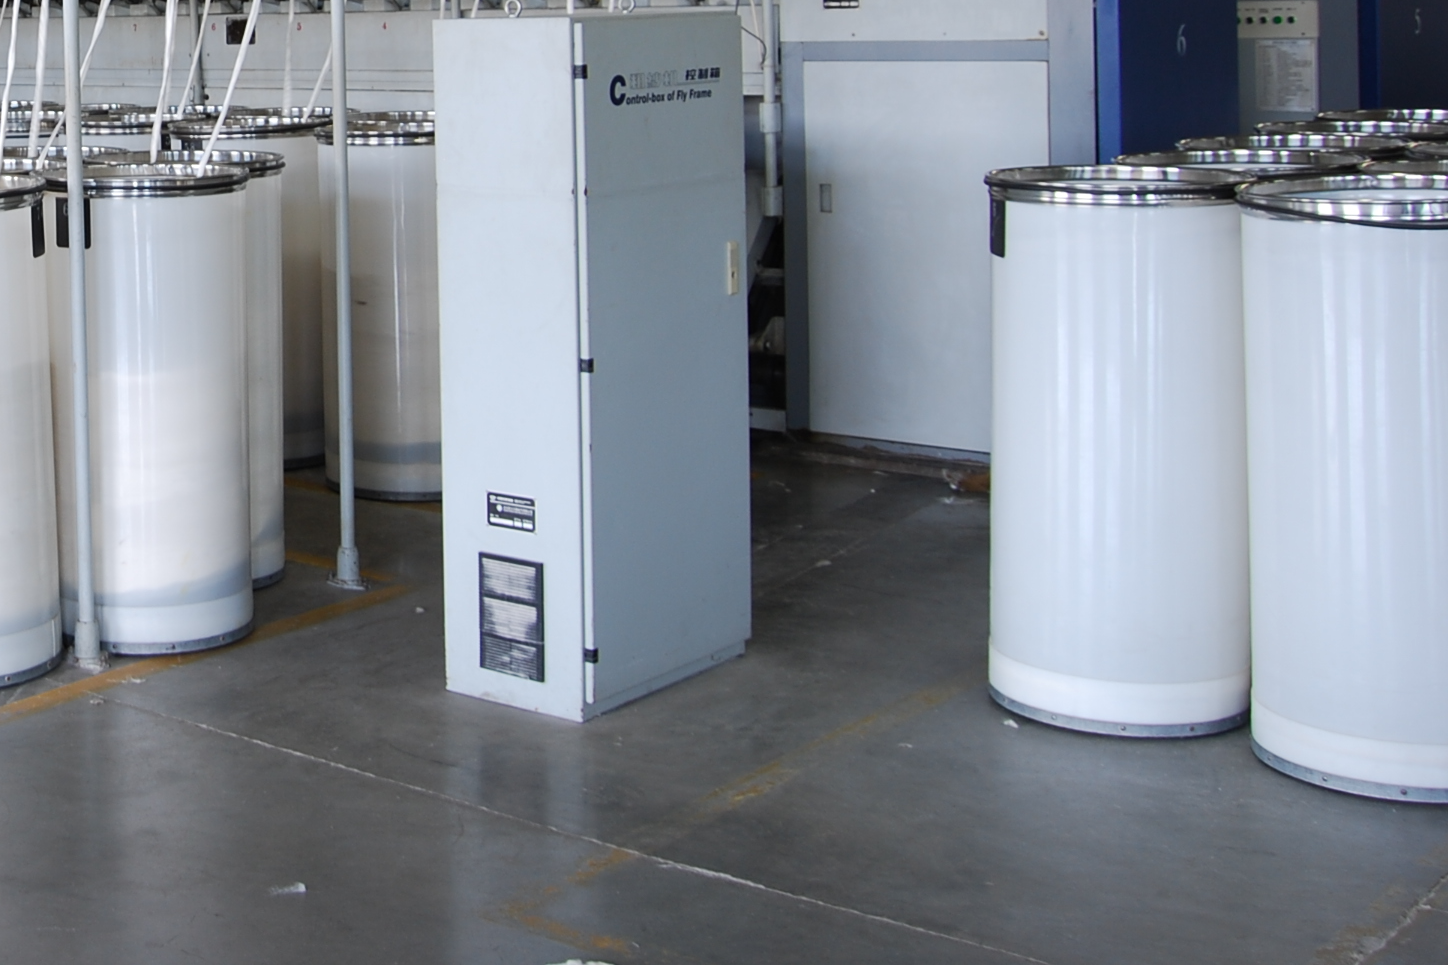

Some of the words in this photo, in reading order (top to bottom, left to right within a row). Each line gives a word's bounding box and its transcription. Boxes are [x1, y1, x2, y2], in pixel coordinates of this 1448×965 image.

[1176, 23, 1188, 57] 6
[609, 74, 665, 106] Control-box
[667, 90, 675, 101] of
[676, 89, 688, 103] Fly
[689, 88, 712, 100] Frame
[685, 67, 721, 81] 控制箱
